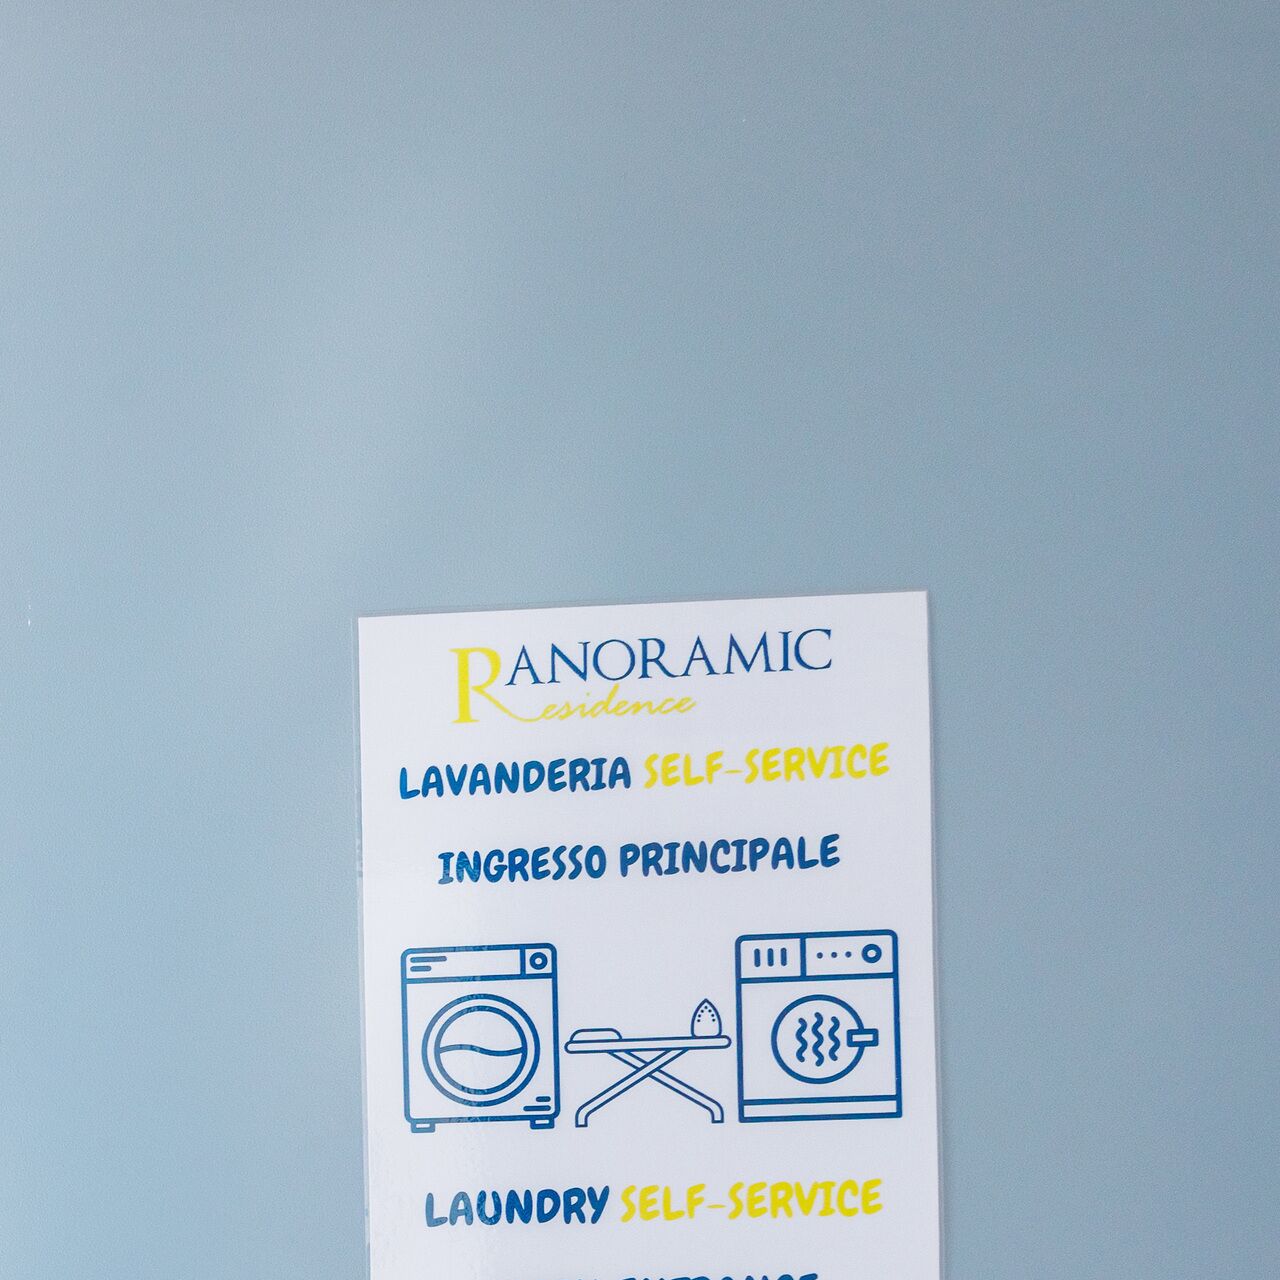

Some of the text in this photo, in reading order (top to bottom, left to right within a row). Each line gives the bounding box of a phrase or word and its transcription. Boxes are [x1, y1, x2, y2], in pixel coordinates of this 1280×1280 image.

[399, 741, 891, 800] LAVANDERIA SELF-SERVICE
[437, 833, 841, 885] INGRESSO PRINCIPALE
[425, 1177, 884, 1228] LAUNDRY SELF-SERVICE
